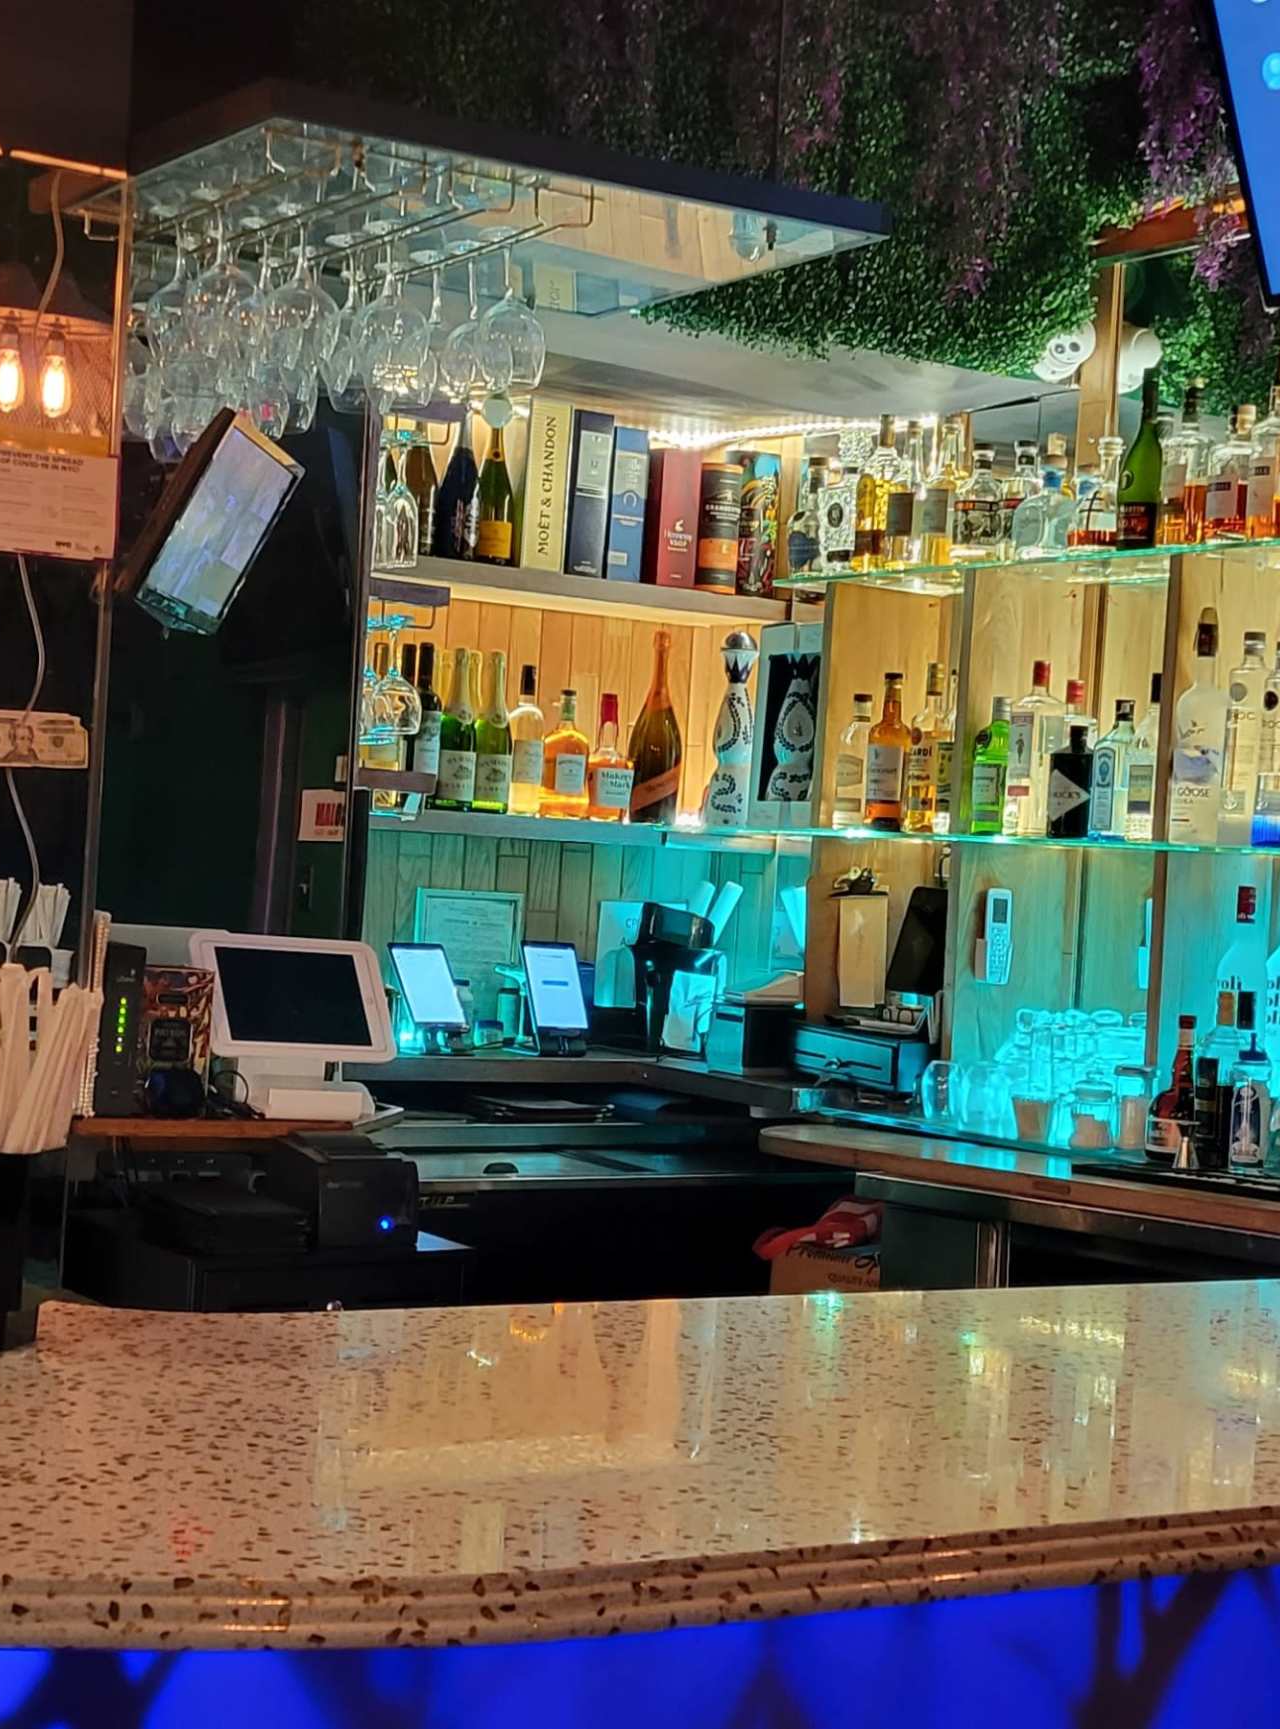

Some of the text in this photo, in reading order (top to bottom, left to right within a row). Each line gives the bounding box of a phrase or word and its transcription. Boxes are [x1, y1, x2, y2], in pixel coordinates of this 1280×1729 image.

[542, 416, 557, 492] CHANDON
[542, 498, 551, 508] &
[1176, 786, 1209, 798] GOOSE
